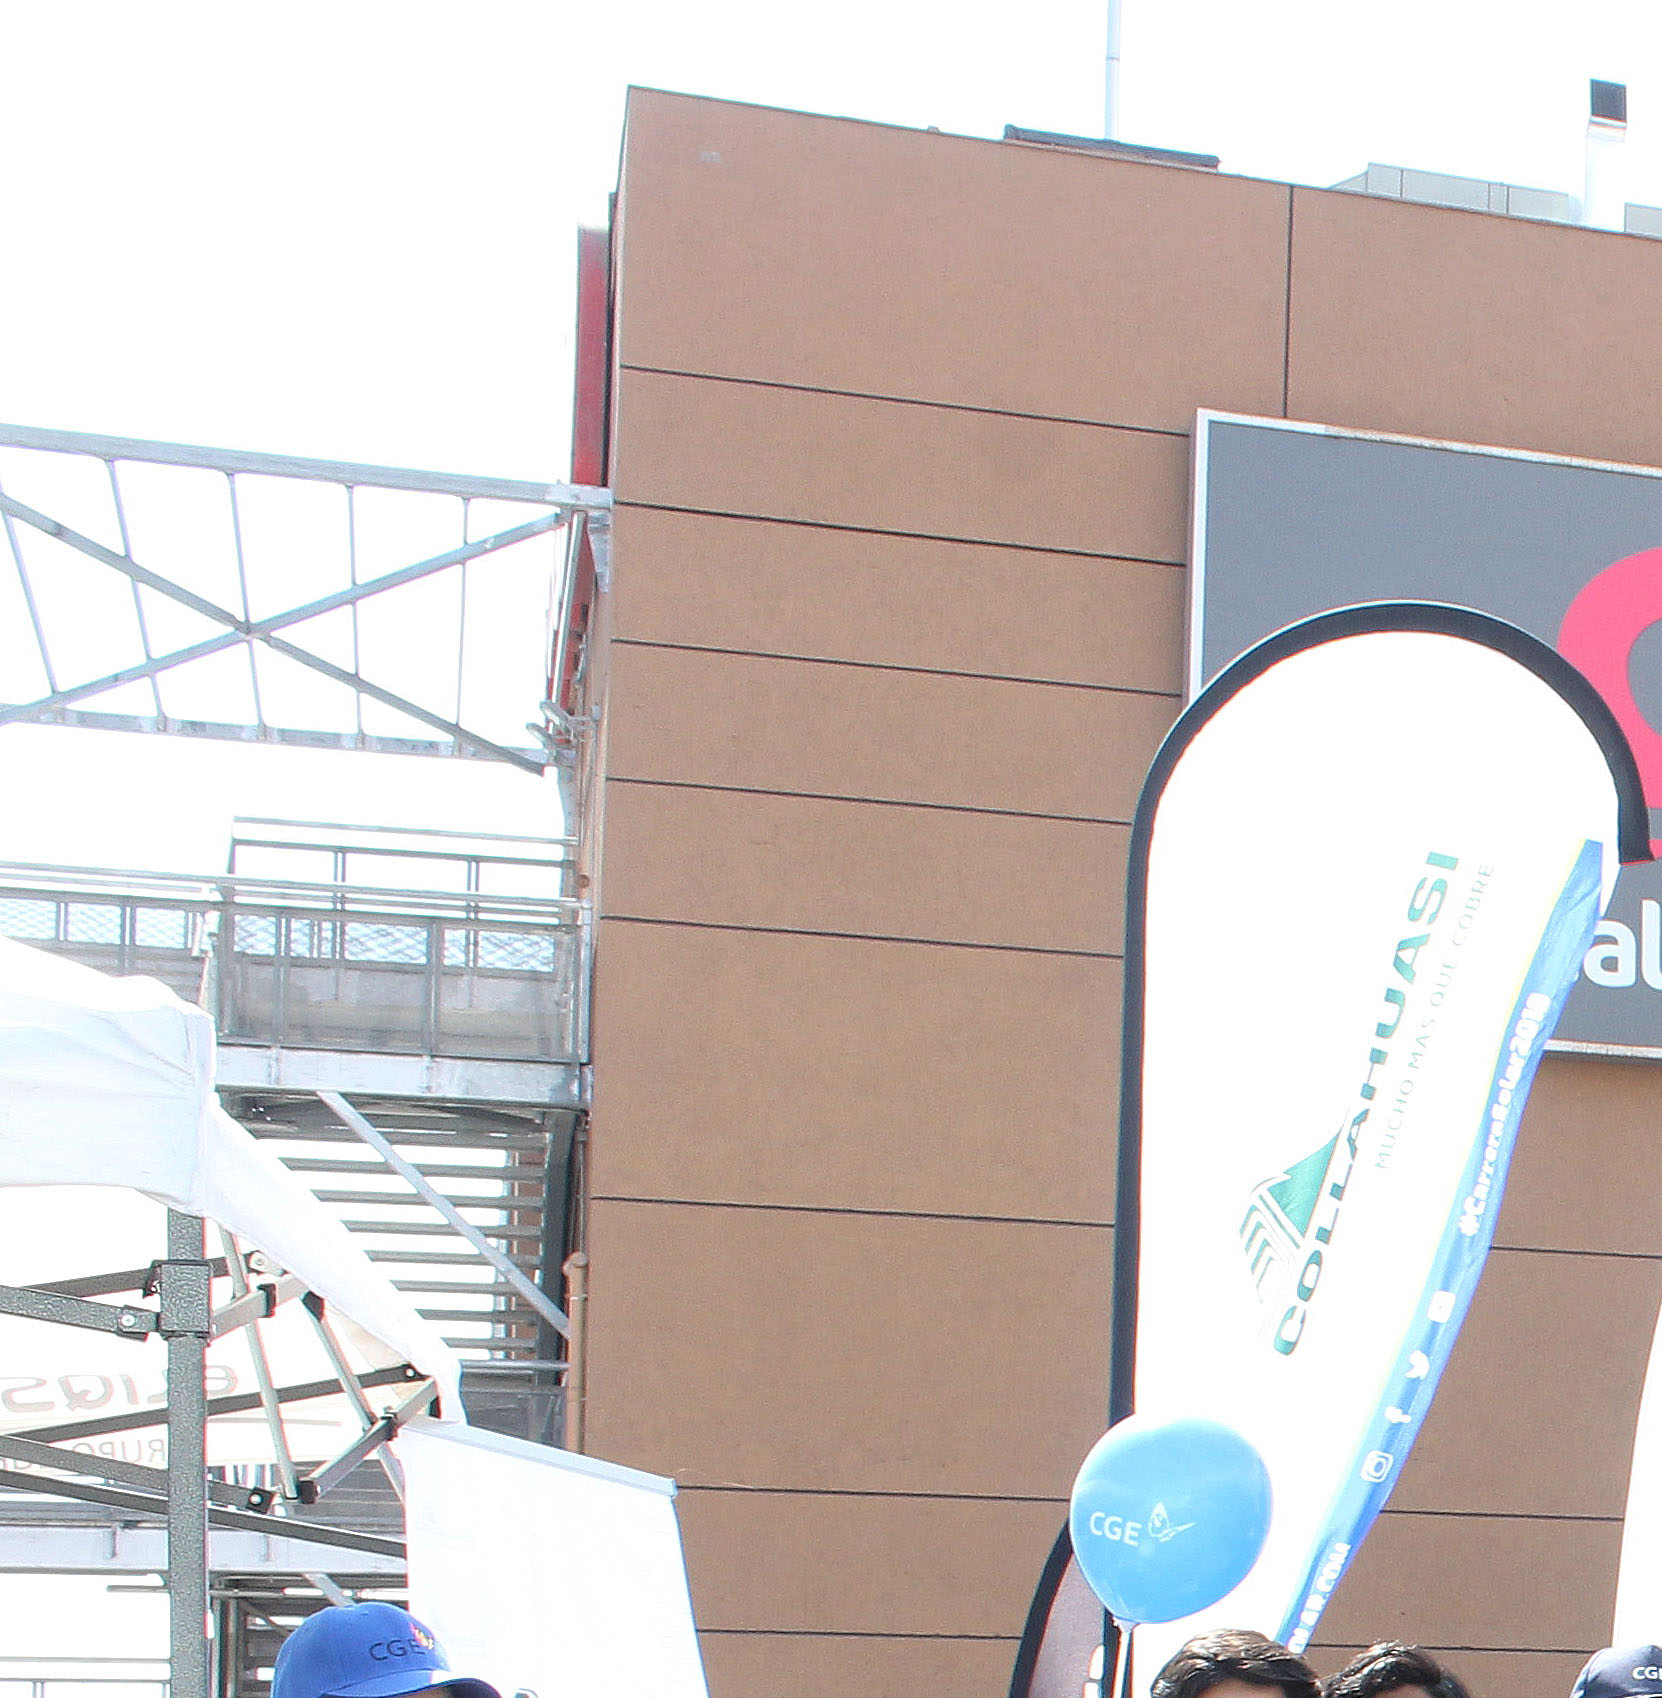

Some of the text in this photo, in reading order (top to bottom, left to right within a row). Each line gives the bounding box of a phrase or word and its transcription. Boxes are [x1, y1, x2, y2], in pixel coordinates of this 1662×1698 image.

[1272, 850, 1461, 1357] COLLAHUASI
[1374, 1079, 1415, 1170] MUCHO
[1408, 1018, 1438, 1070] MAS
[1089, 1511, 1142, 1547] CGE
[369, 1639, 425, 1662] CGE
